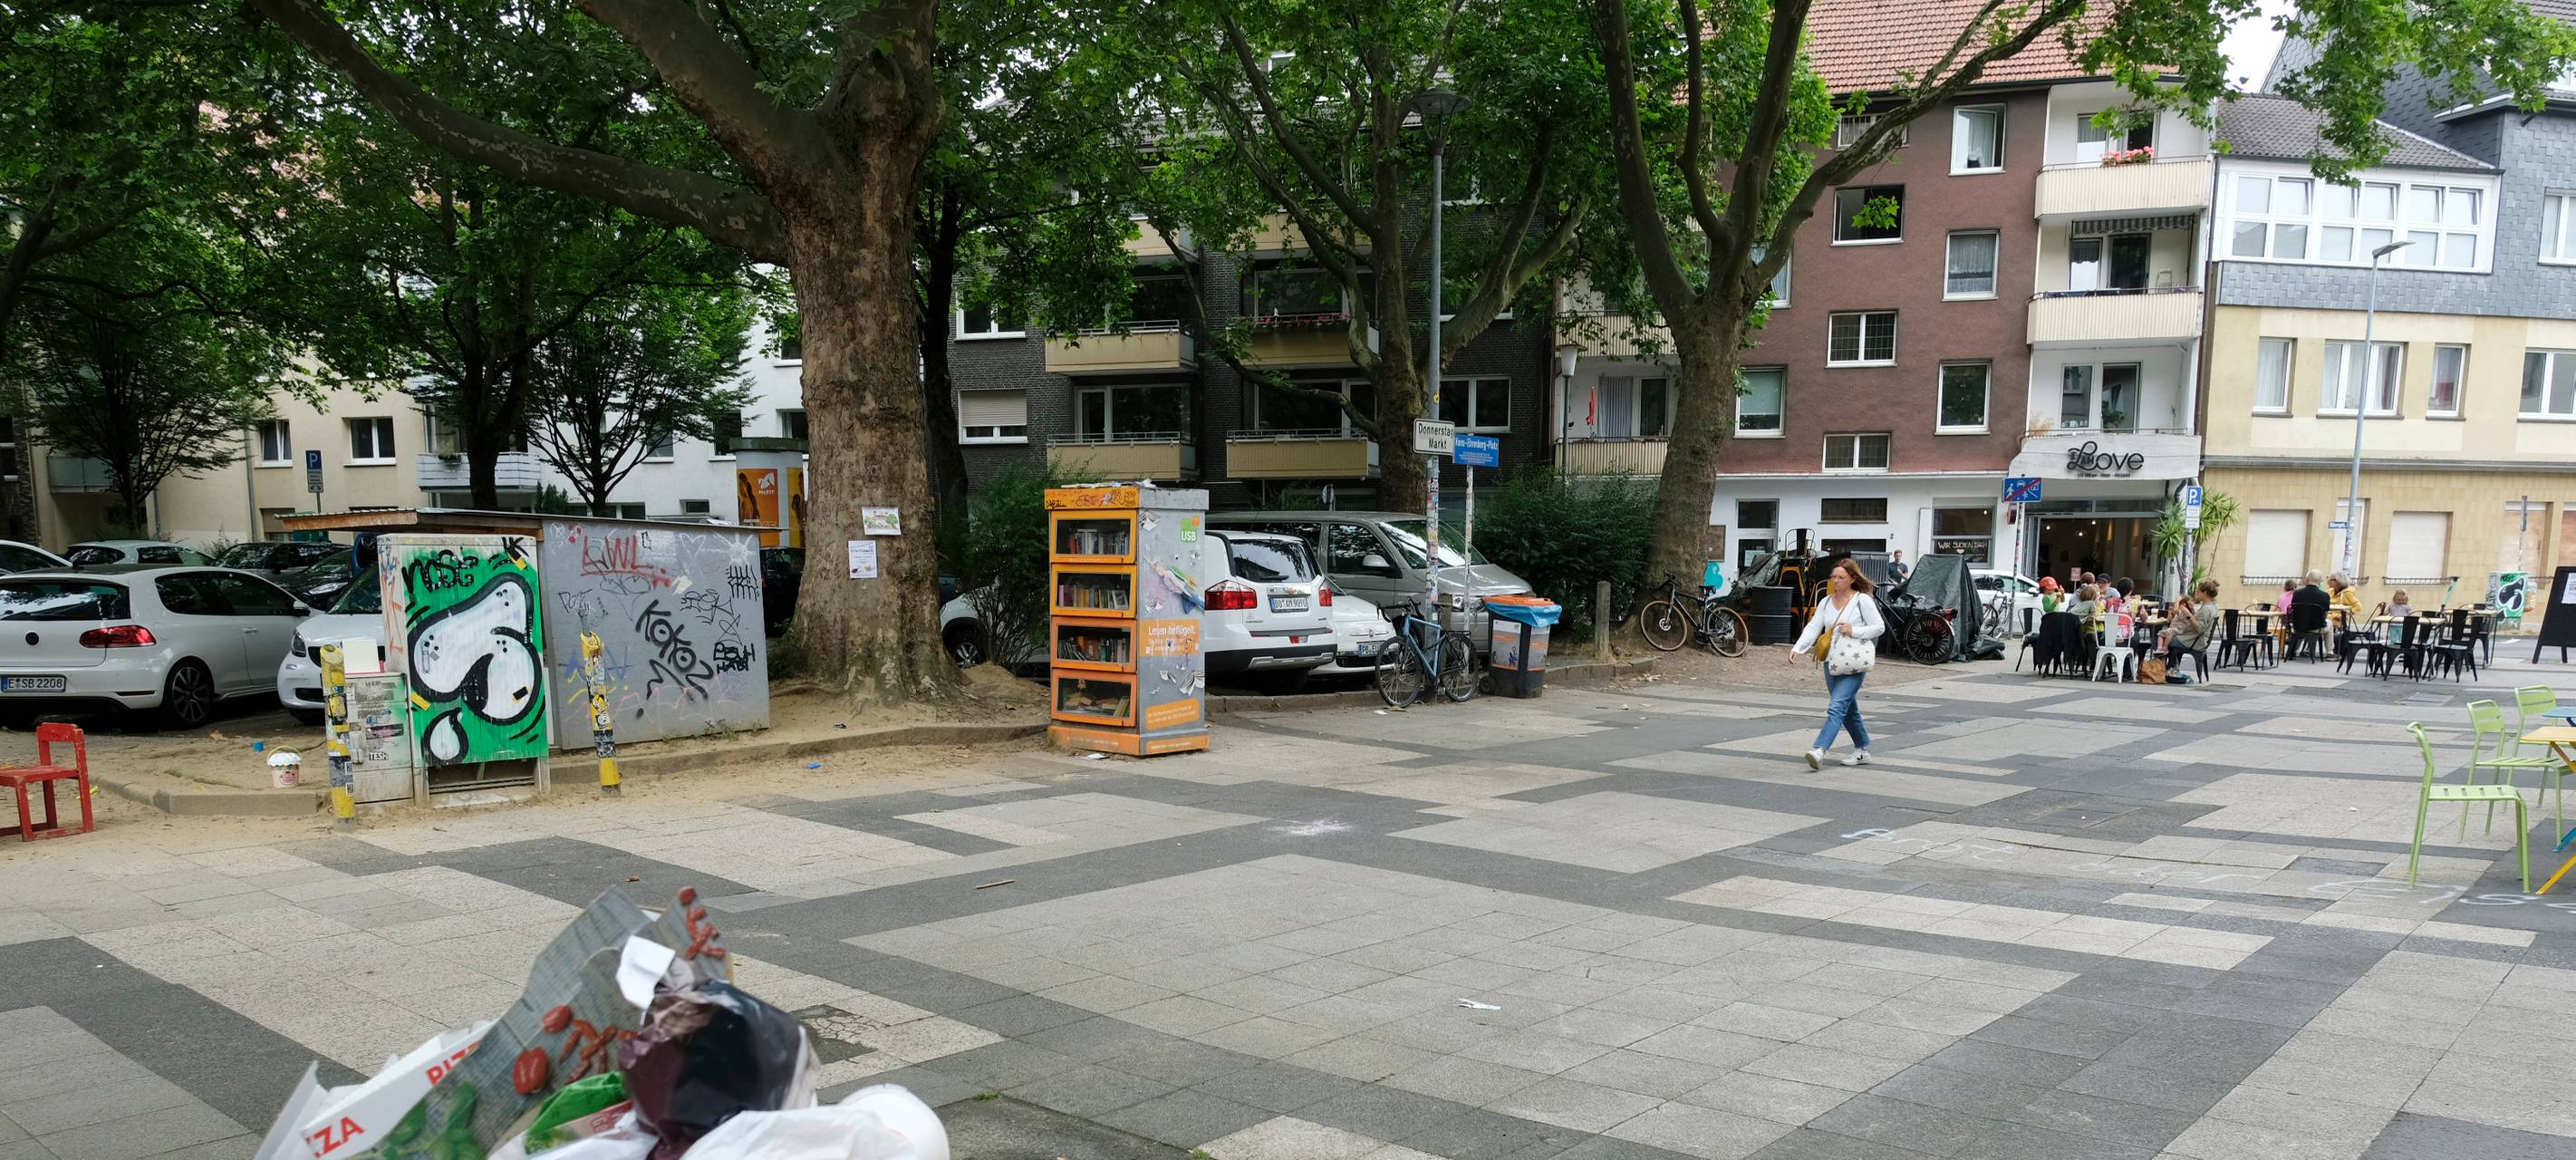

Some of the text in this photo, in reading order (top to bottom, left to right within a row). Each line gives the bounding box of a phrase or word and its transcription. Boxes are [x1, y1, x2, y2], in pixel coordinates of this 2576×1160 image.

[1418, 422, 1453, 437] Donnerstag
[1428, 438, 1447, 450] Markt
[1181, 530, 1197, 542] USB
[1148, 626, 1167, 636] Lesen
[8, 678, 63, 688] E SB 2208
